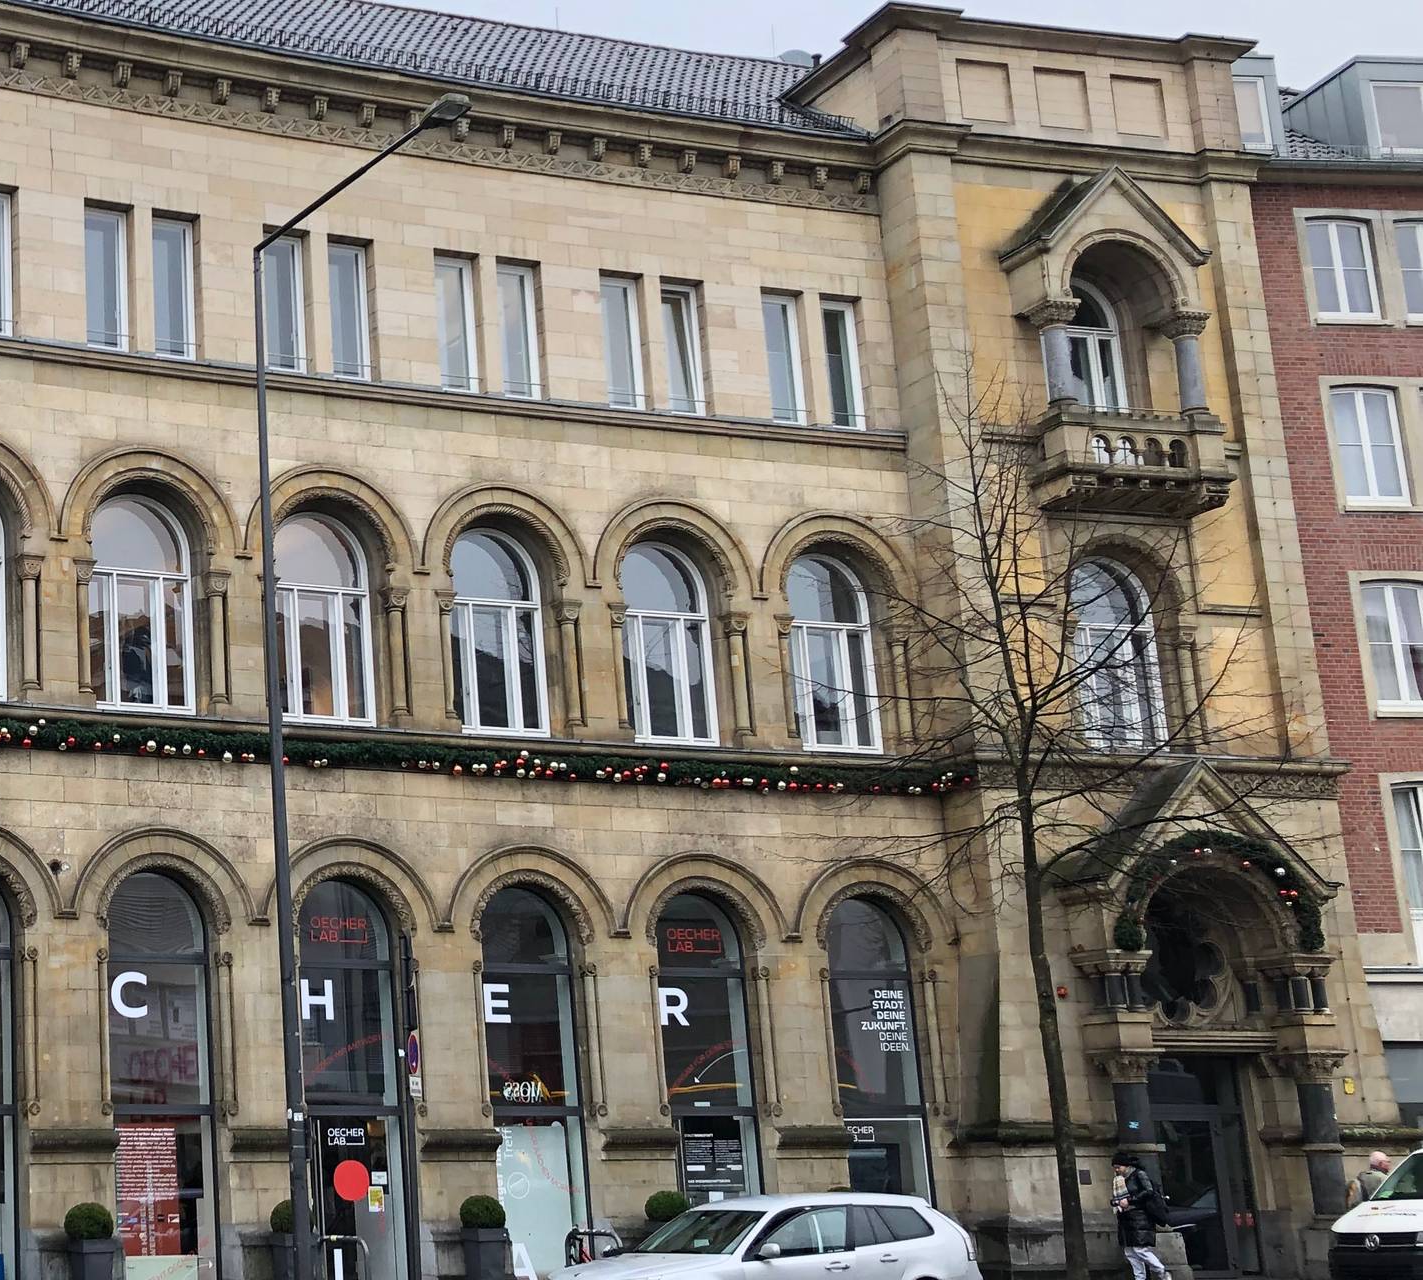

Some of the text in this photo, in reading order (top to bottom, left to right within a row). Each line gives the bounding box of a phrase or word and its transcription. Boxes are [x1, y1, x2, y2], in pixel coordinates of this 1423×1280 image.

[310, 916, 367, 929] OECHER
[310, 929, 338, 942] LAB
[667, 928, 721, 941] OECHER
[668, 941, 694, 953] LAB
[874, 990, 904, 999] DEINE
[872, 1000, 906, 1010] STADT.
[877, 1011, 906, 1020] DEINE
[861, 1021, 909, 1031] ZUKUNFT.
[879, 1032, 908, 1041] DEINE
[880, 1042, 911, 1052] IDEEN.
[327, 1128, 365, 1137] OECHER
[328, 1137, 347, 1146] LAB
